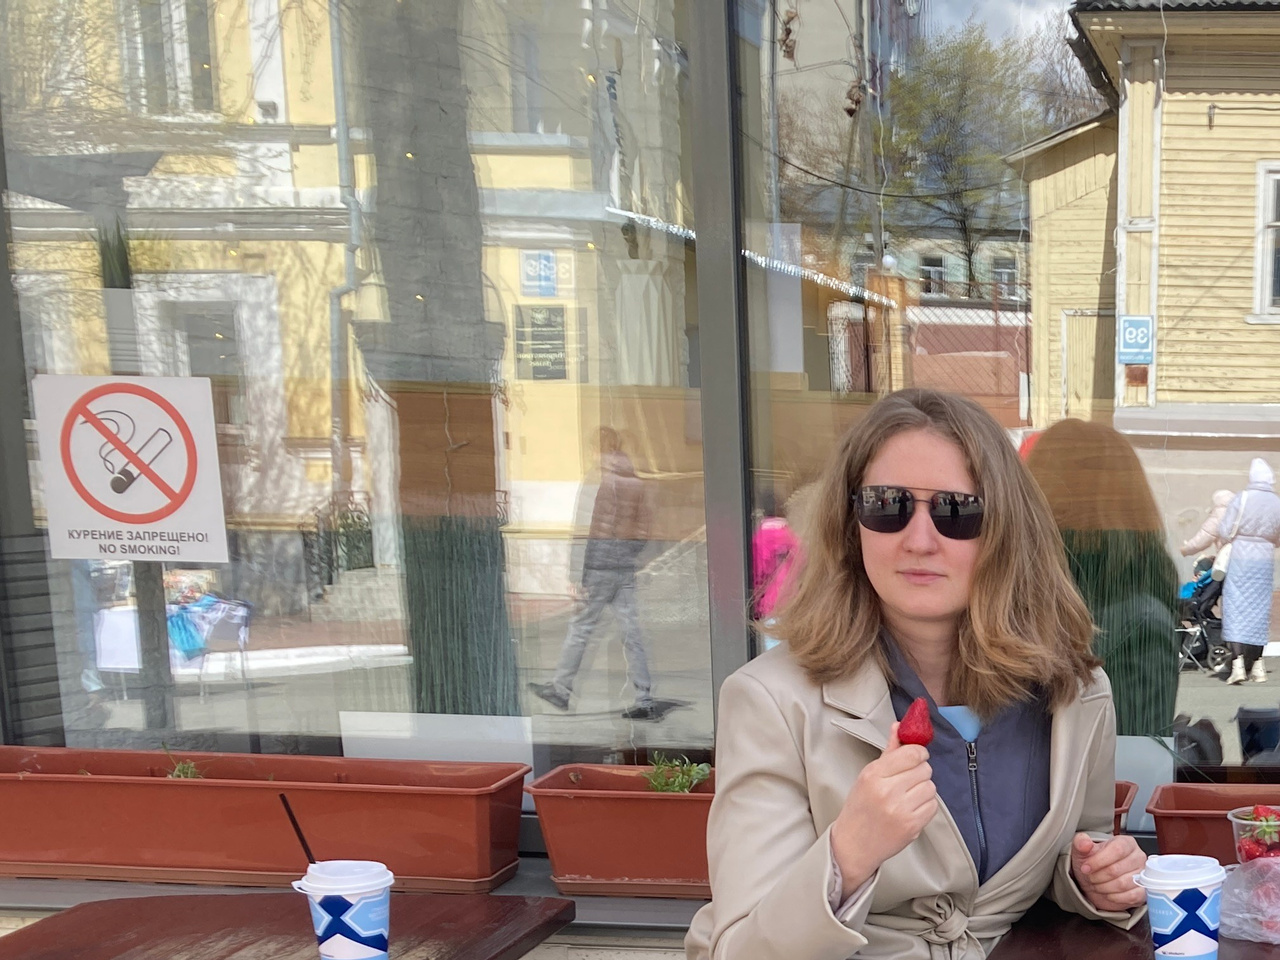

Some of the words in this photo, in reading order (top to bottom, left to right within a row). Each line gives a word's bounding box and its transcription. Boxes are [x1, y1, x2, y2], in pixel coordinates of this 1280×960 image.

[67, 529, 124, 541] КУРЕНИЕ
[126, 531, 209, 543] ЗАПРЕЩЕНО!
[98, 544, 117, 554] NO
[120, 544, 181, 556] SMOKING!
